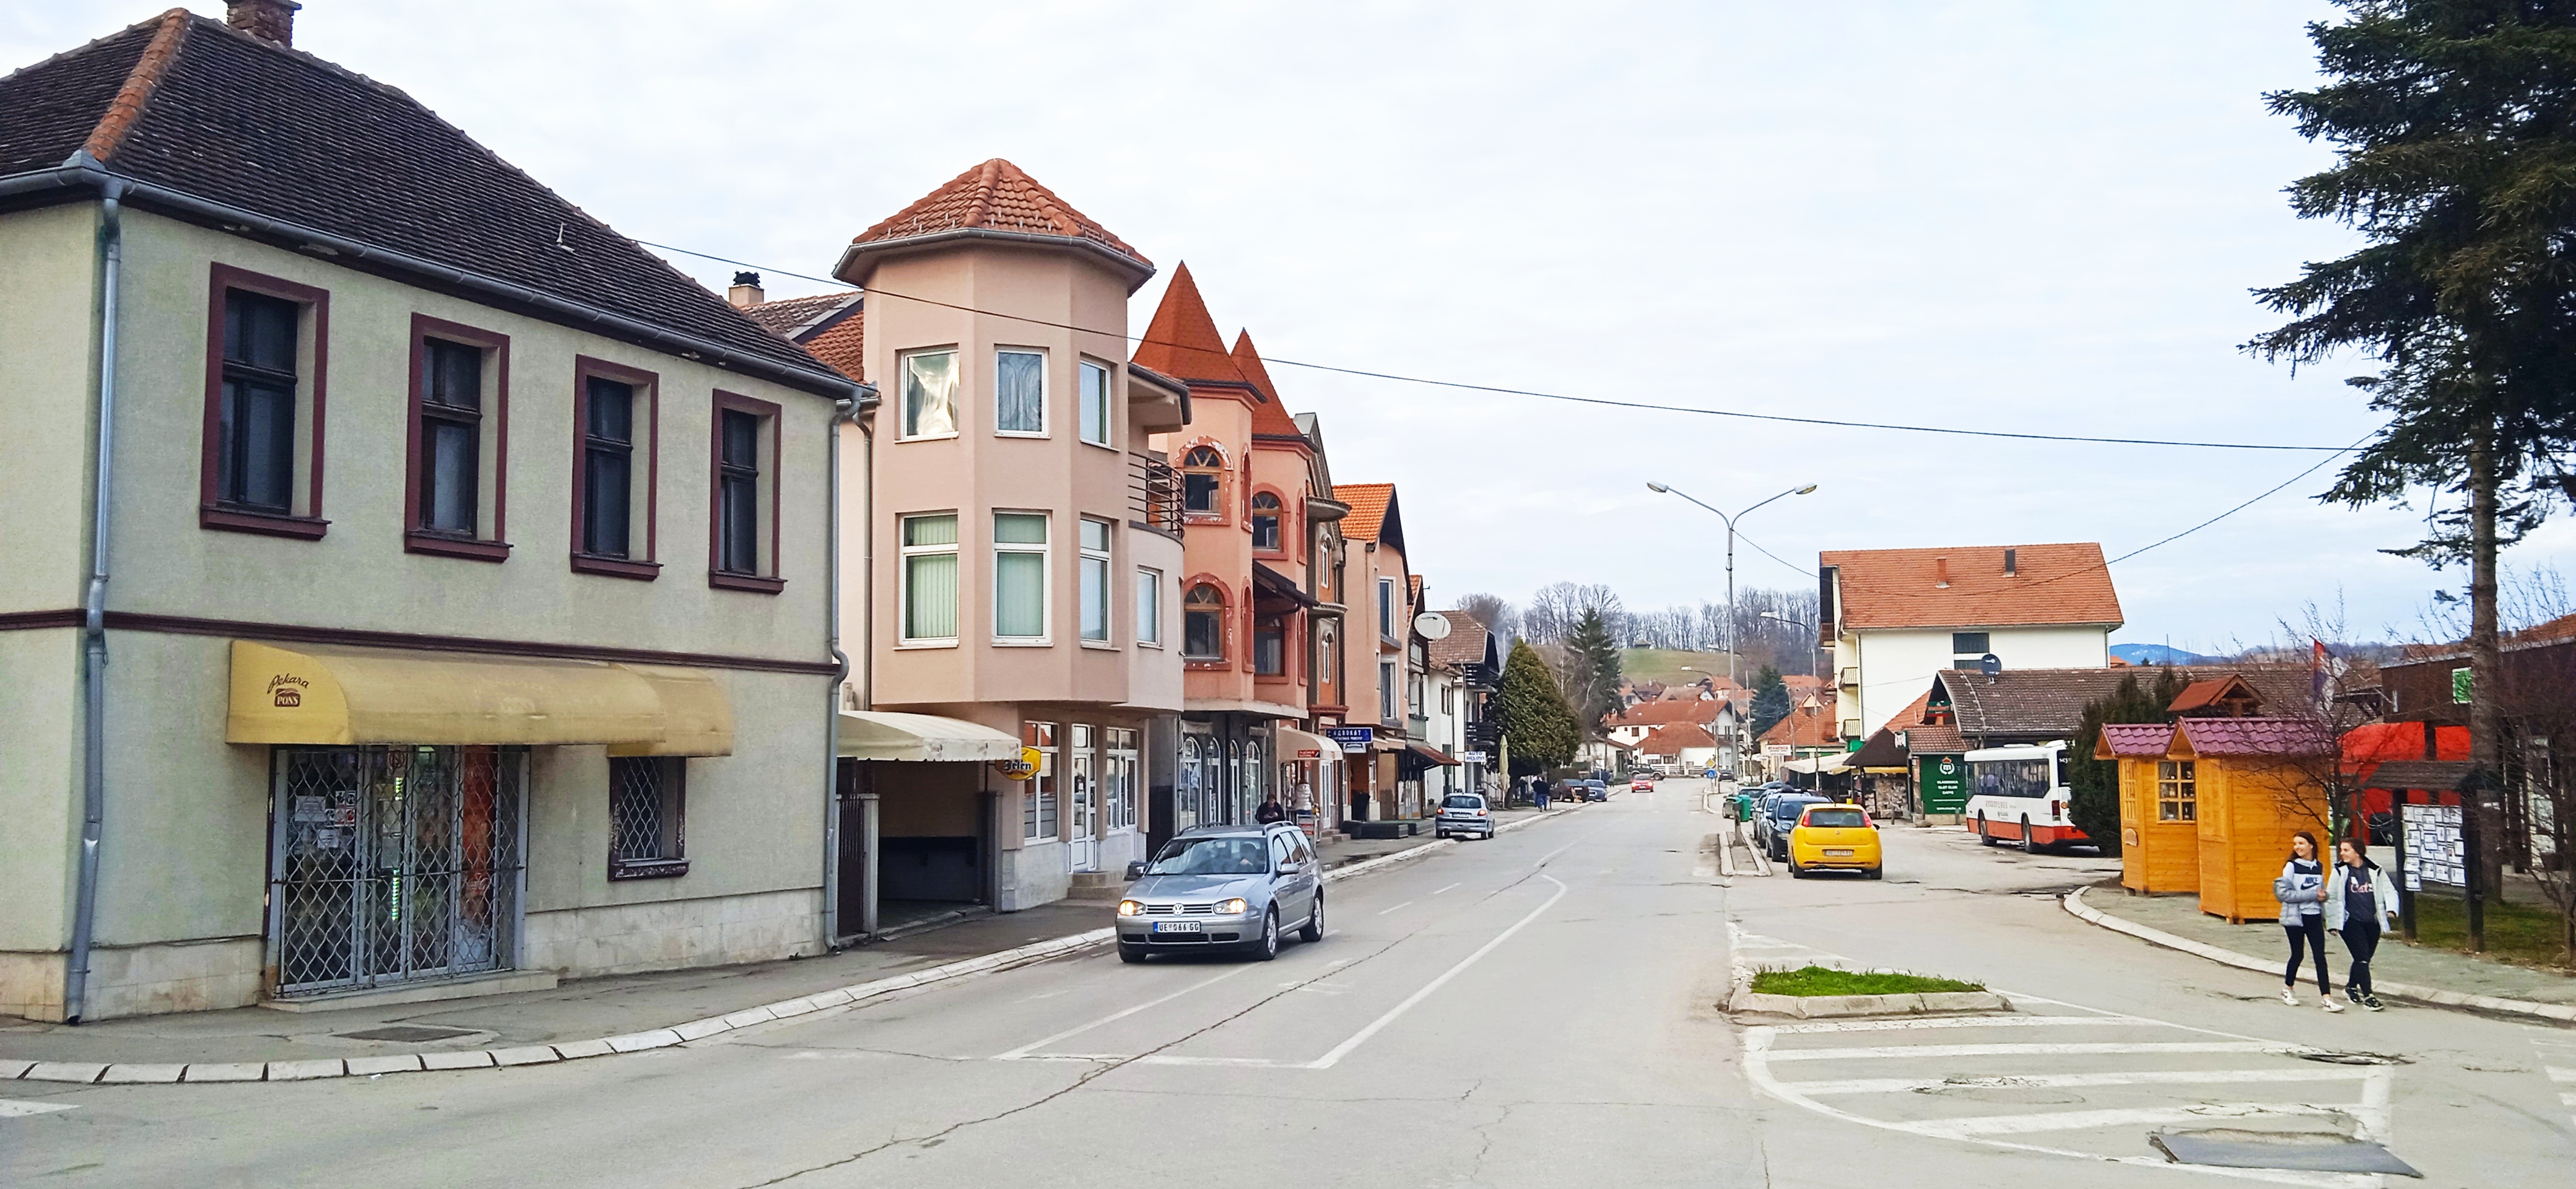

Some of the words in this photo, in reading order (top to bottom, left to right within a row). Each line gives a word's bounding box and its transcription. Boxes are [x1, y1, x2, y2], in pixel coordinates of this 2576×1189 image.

[267, 673, 309, 694] Pekara
[277, 696, 298, 705] PONS
[1004, 759, 1032, 771] Jelen
